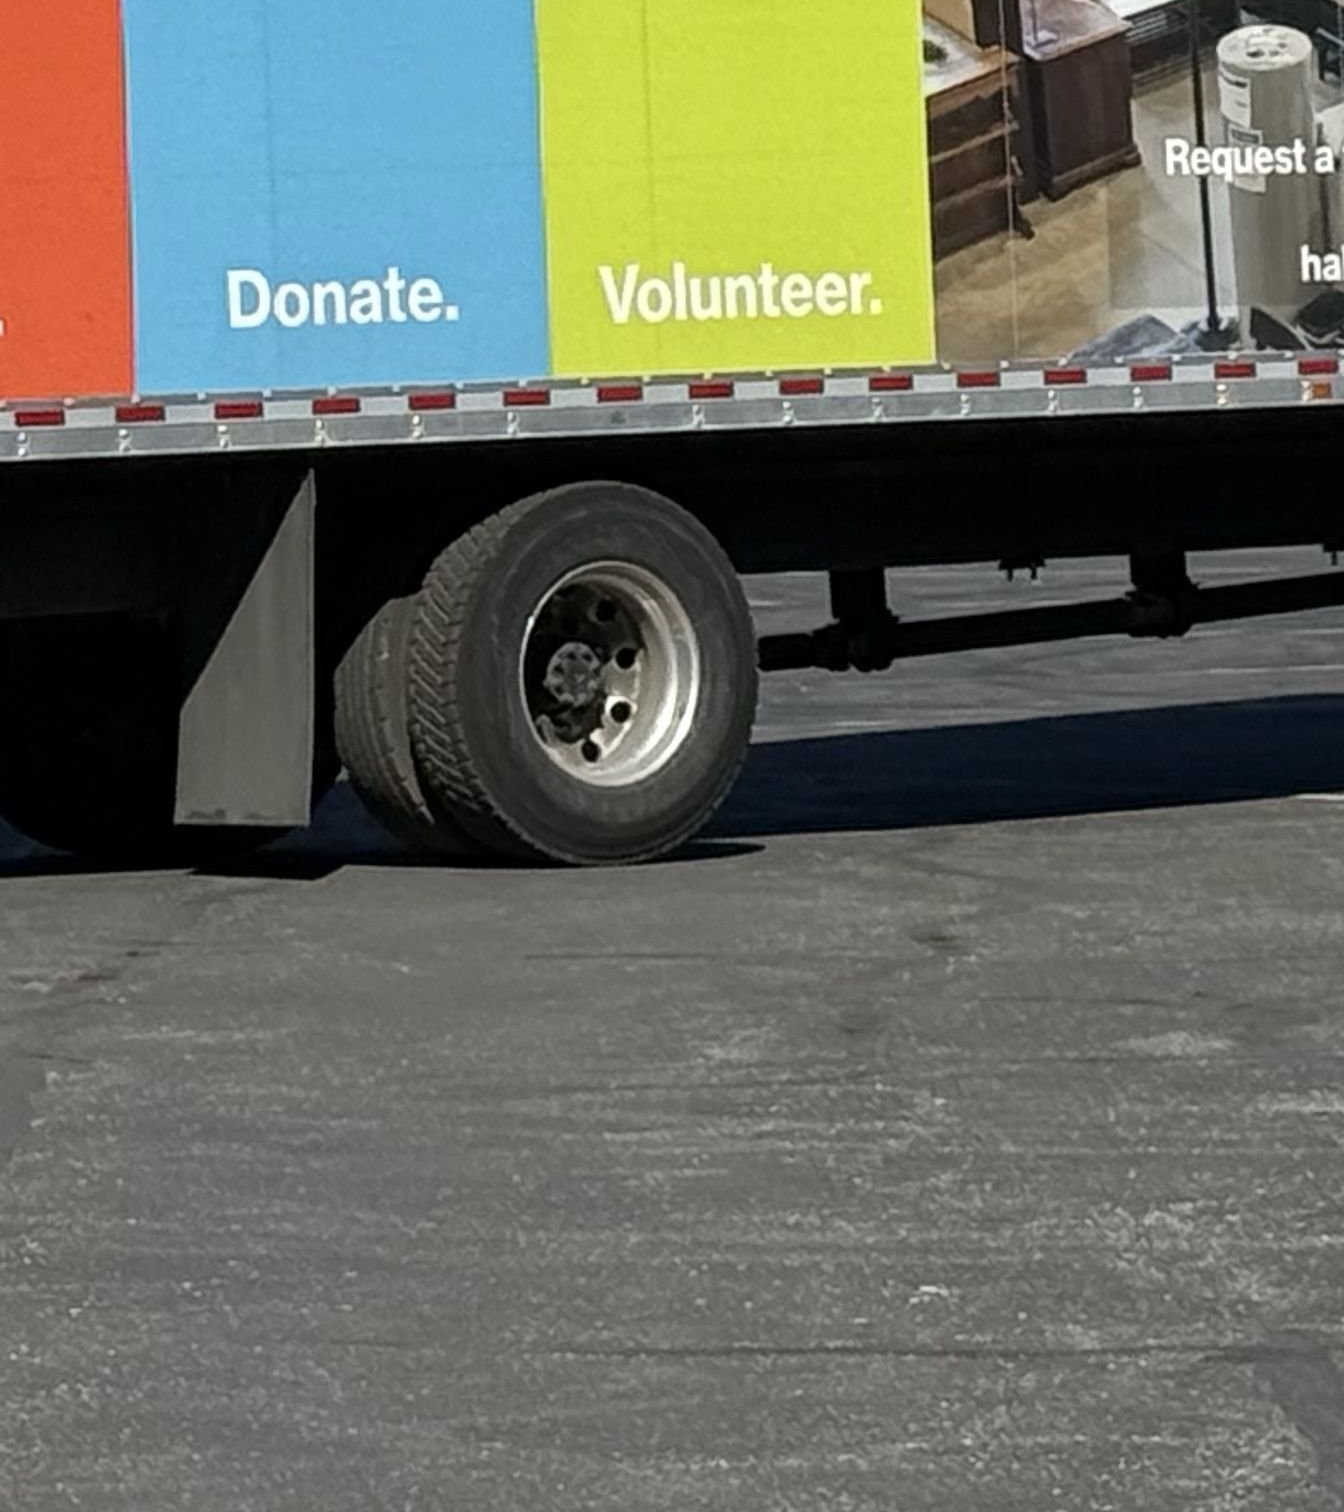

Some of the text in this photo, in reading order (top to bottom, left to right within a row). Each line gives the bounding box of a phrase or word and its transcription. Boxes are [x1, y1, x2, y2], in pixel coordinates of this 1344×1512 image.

[1164, 136, 1305, 183] Request
[1313, 142, 1335, 171] a
[226, 267, 459, 330] Donate.
[597, 261, 882, 324] Volunteer.
